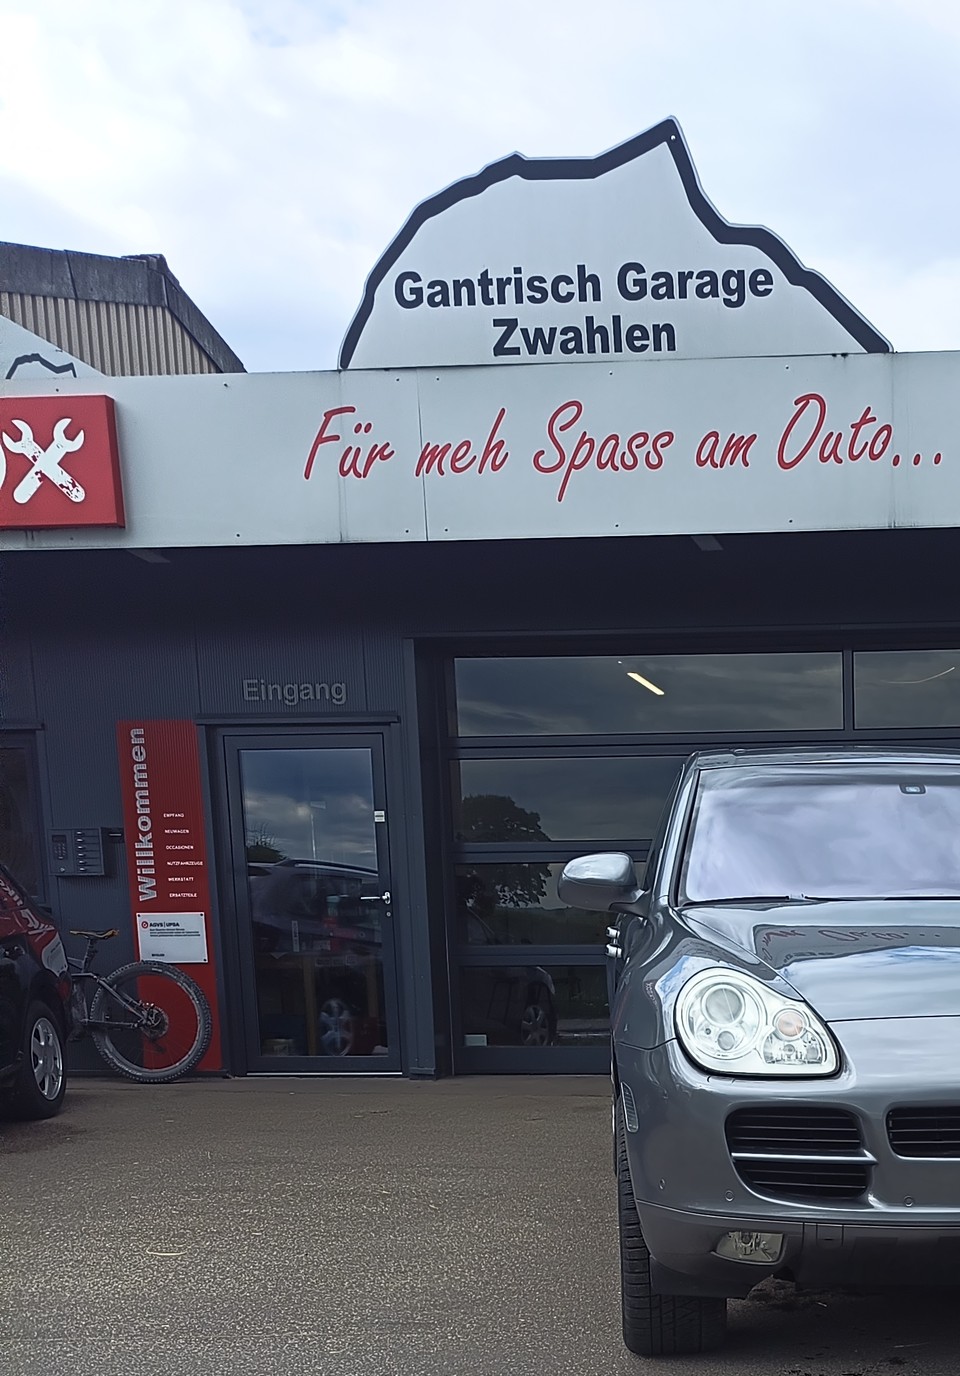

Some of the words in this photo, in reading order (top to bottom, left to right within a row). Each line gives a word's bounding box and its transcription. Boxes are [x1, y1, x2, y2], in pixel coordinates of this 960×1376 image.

[394, 263, 601, 309] Gantrisch
[617, 261, 774, 307] Garage
[492, 314, 676, 357] Zwahlen
[304, 406, 395, 480] Für
[415, 406, 508, 476] meh
[533, 399, 675, 502] Spass
[696, 431, 757, 469] am
[242, 678, 347, 705] Eingang
[131, 728, 157, 901] Willkommen
